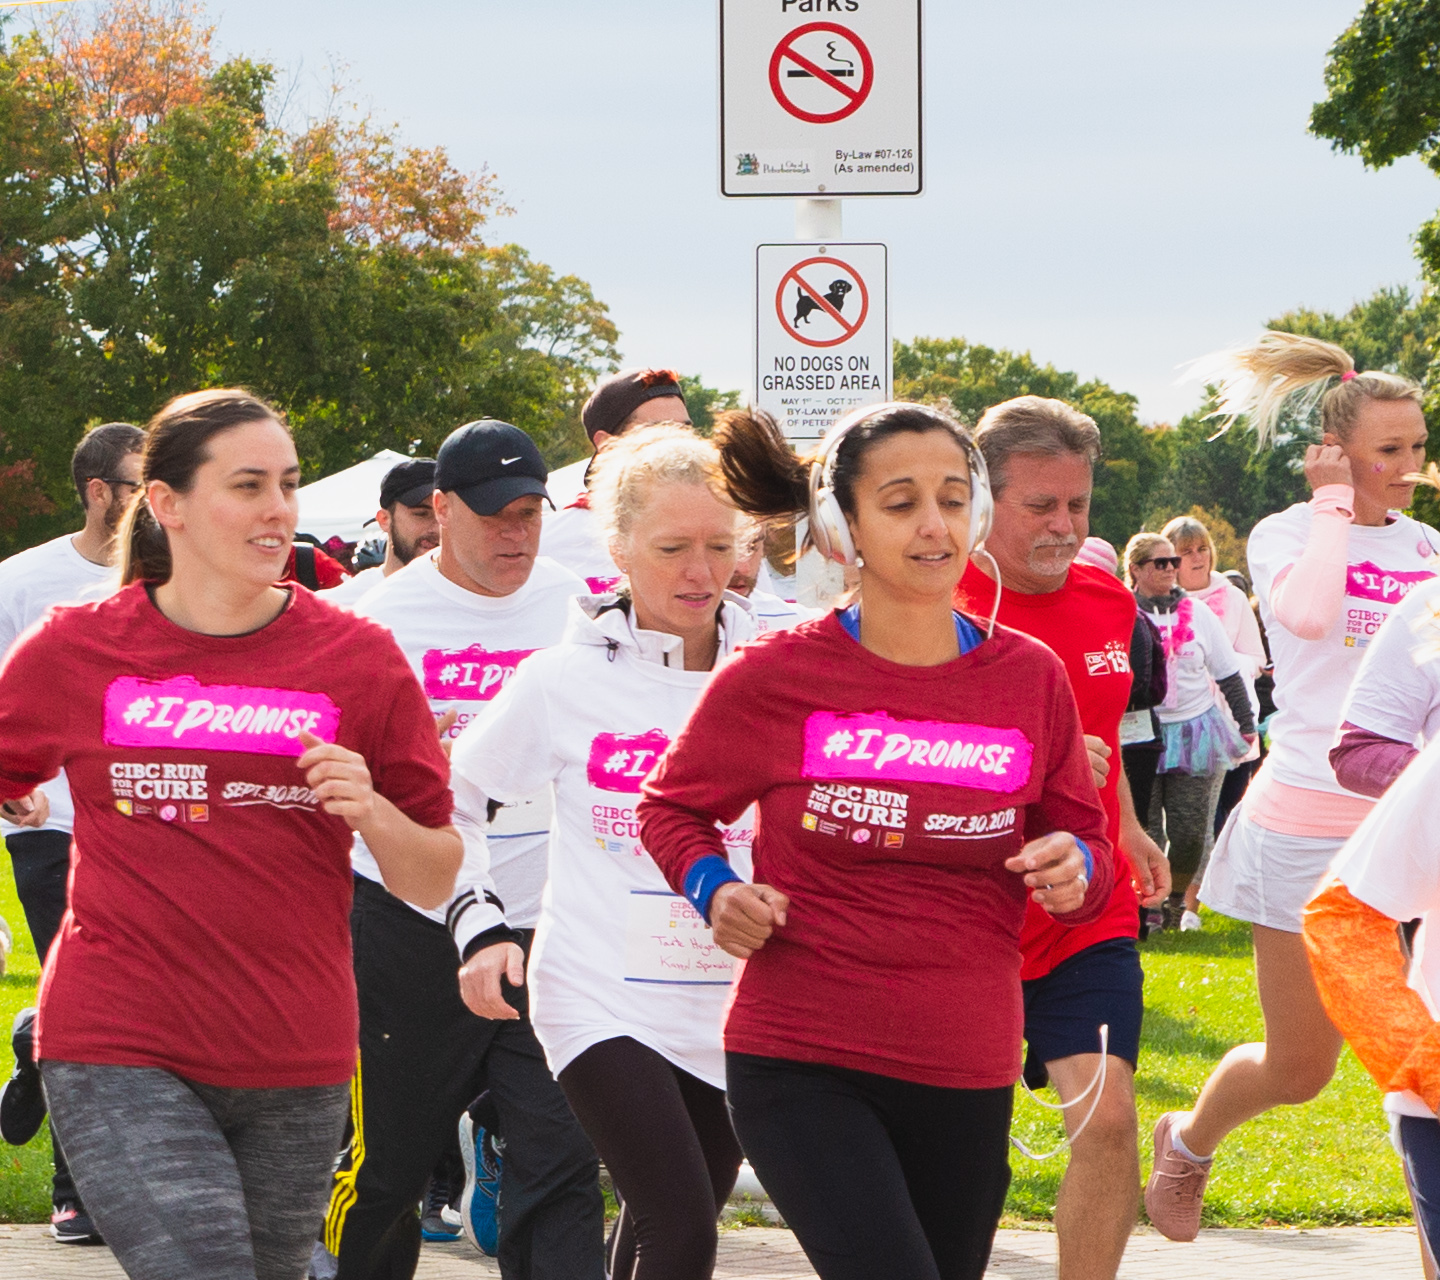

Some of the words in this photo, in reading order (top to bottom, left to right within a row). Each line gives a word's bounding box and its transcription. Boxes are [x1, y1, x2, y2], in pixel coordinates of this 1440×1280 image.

[835, 150, 872, 161] By-Law
[875, 149, 913, 159] #07-126
[834, 163, 853, 175] (As
[857, 162, 914, 175] amended)
[774, 356, 795, 372] NO
[801, 356, 843, 372] DOGS
[848, 356, 869, 371] ON
[763, 375, 835, 390] GRASSED
[840, 375, 881, 390] AREA
[827, 397, 845, 405] OCT
[1347, 609, 1380, 621] CIBC
[109, 763, 160, 779] CIBC
[162, 763, 208, 780] RUN
[134, 780, 208, 800] CURE
[810, 790, 831, 804] FOR
[864, 785, 909, 809] RUN
[592, 805, 632, 820] CIBC
[807, 799, 829, 814] THE
[832, 799, 907, 829] CURE
